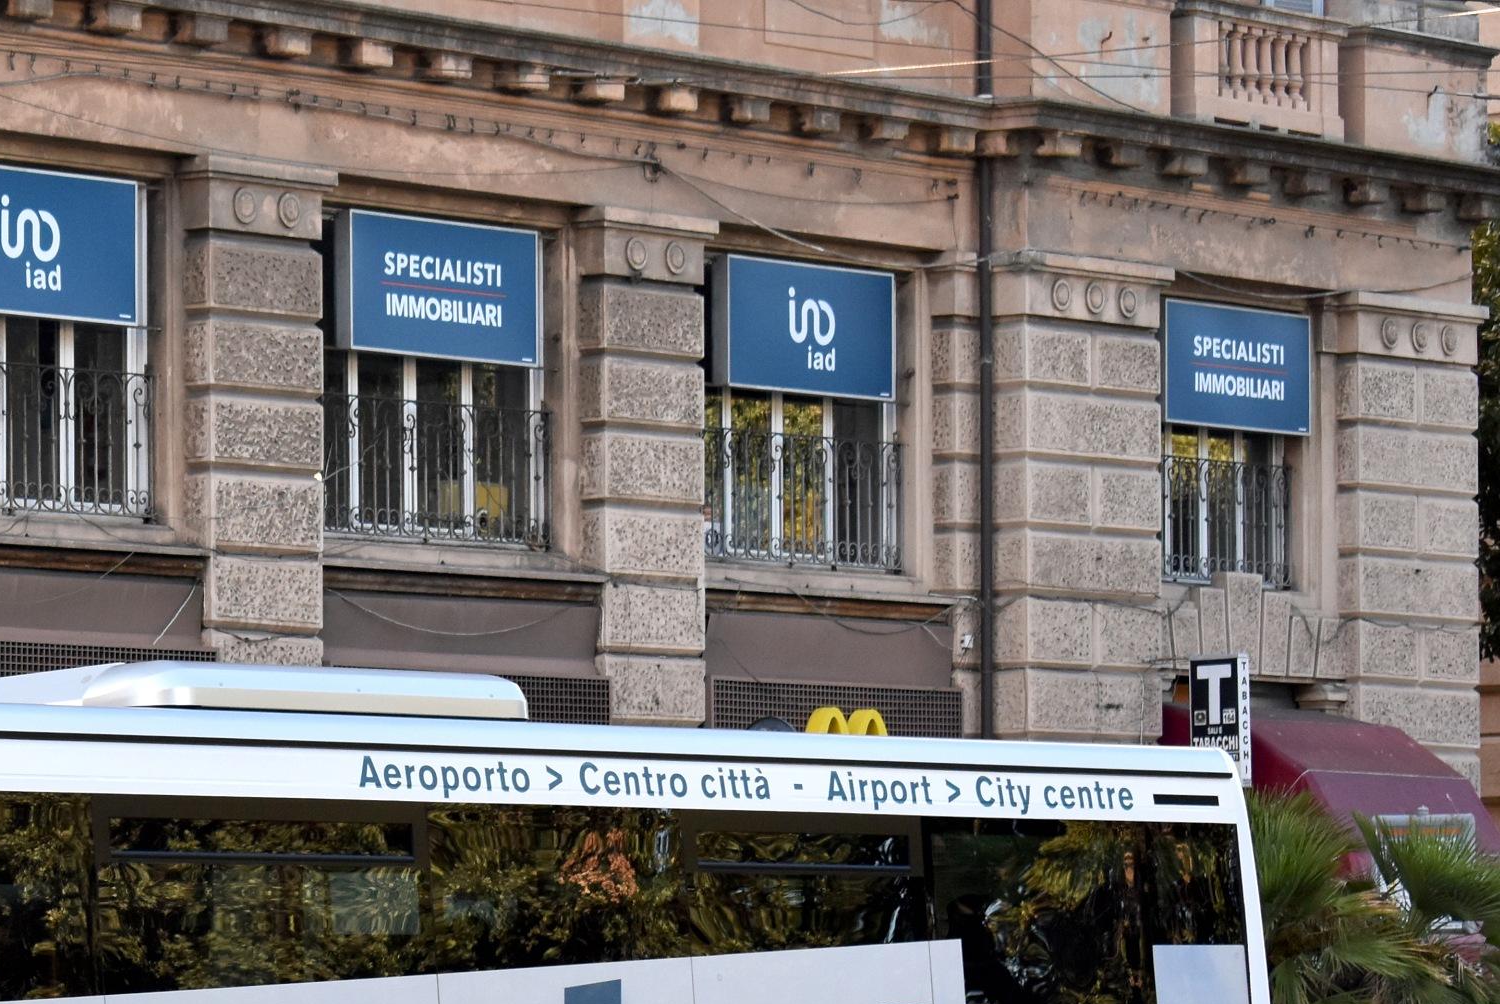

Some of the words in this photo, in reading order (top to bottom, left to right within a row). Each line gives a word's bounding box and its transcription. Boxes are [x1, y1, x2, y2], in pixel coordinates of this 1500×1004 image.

[25, 261, 62, 292] iad
[384, 251, 502, 288] SPECIALISTI
[386, 292, 502, 328] IMMOBILIARI
[807, 344, 836, 372] iad
[1193, 335, 1285, 366] SPECIALISTI
[1194, 371, 1285, 401] IMMOBILIARI
[1197, 664, 1231, 725] T
[1241, 661, 1250, 775] TABACCHI
[359, 755, 531, 798] Aeroporto
[579, 761, 688, 798] Centro
[700, 767, 771, 800] città
[827, 770, 933, 811] Airport
[975, 775, 1031, 816] City
[1043, 781, 1134, 811] centre
